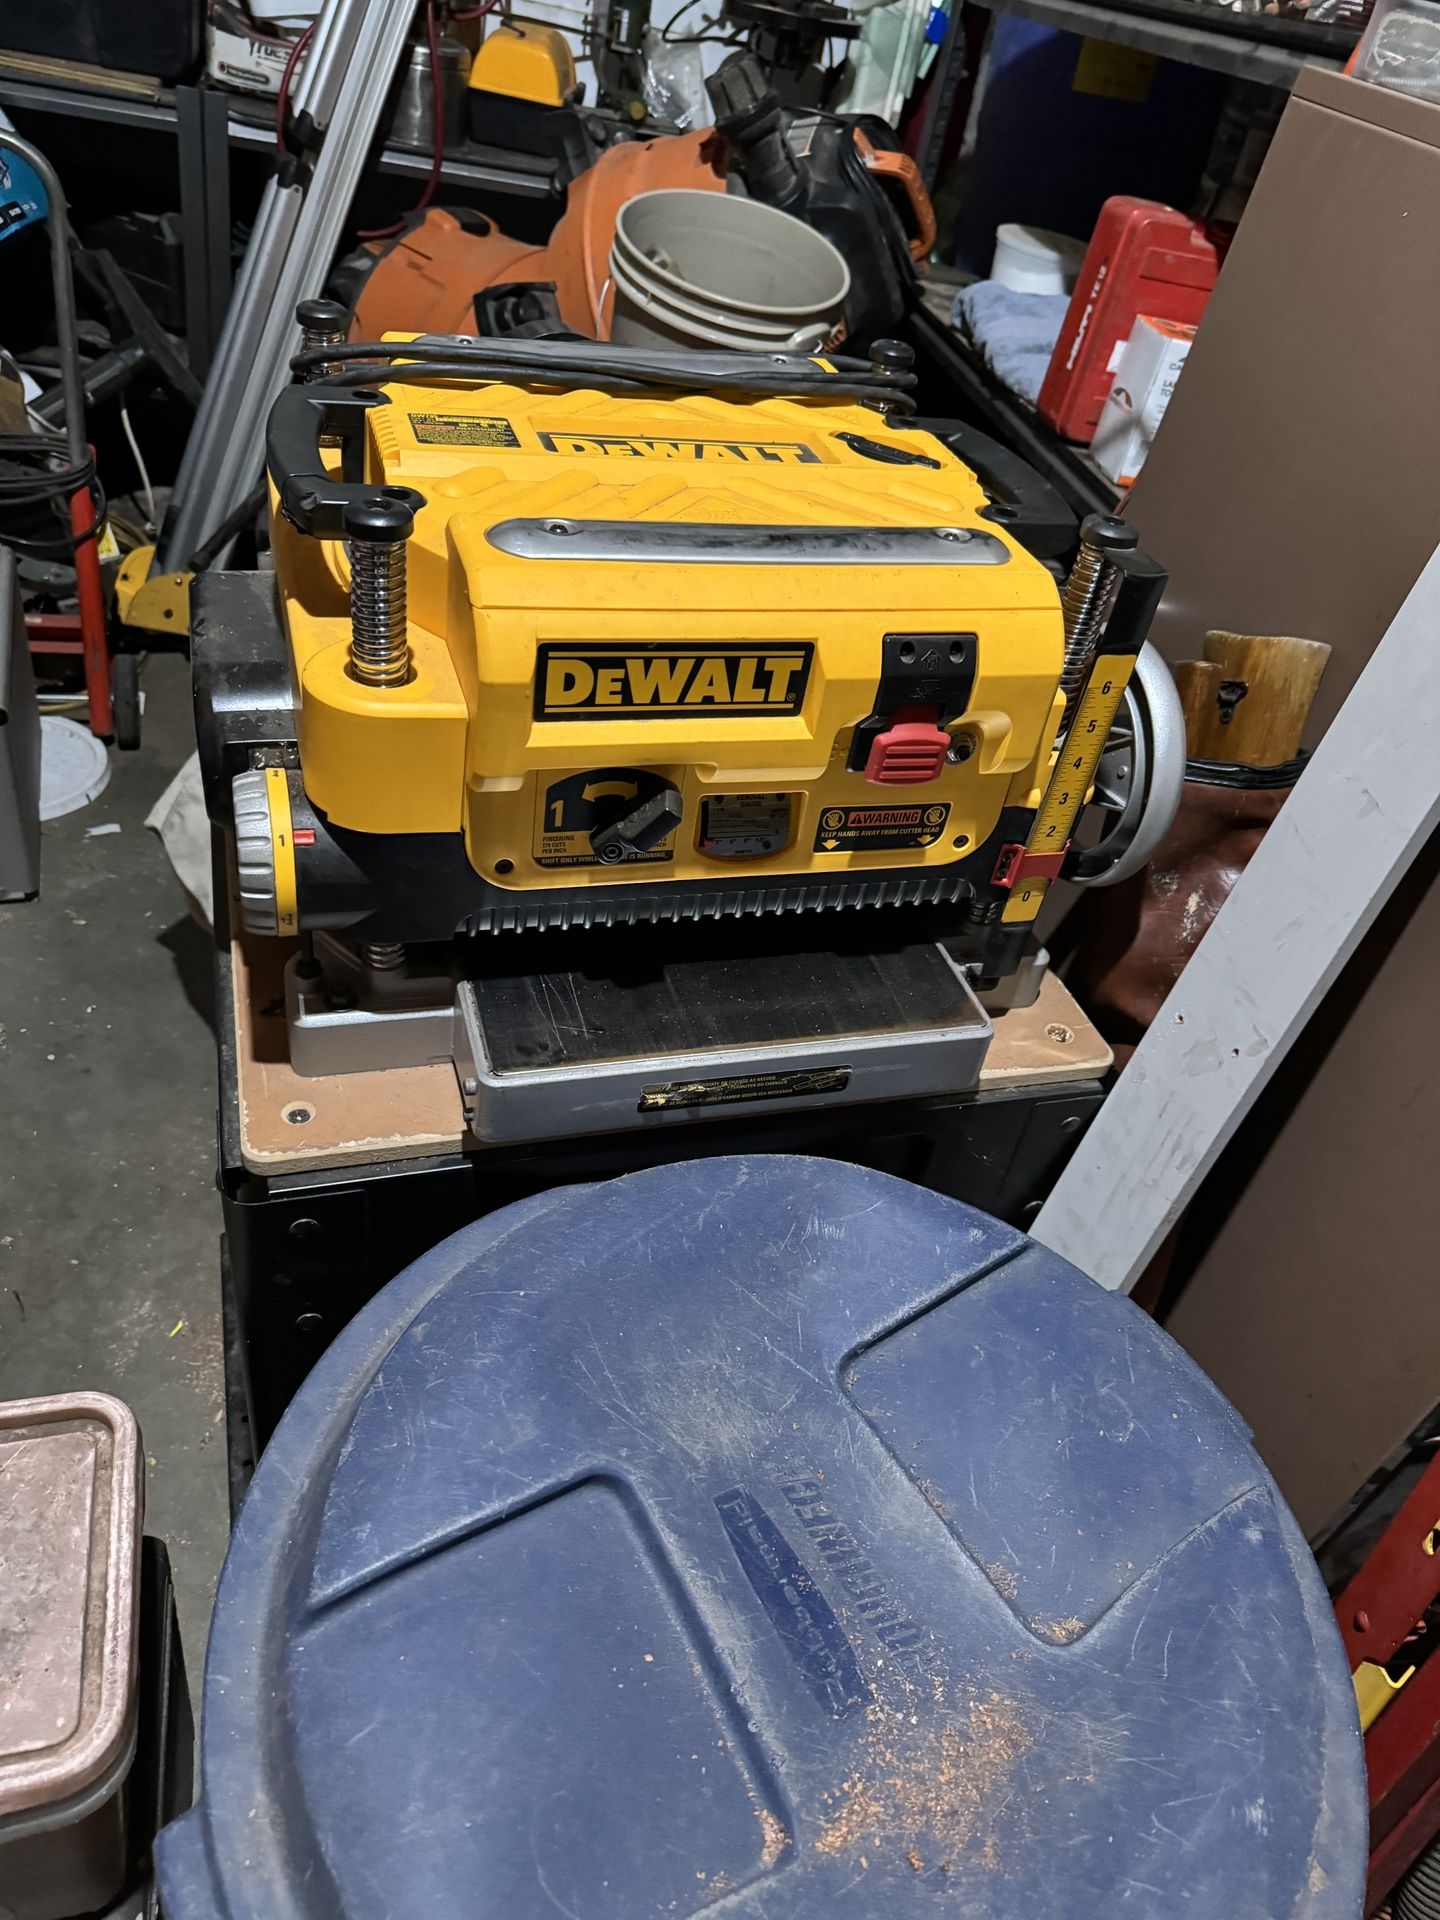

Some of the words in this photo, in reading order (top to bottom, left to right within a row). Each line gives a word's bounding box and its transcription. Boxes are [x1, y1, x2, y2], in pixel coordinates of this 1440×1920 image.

[545, 658, 804, 706] DEWALT
[1101, 681, 1113, 695] 6
[1087, 719, 1096, 733] 5
[1072, 756, 1083, 770] 4
[1058, 792, 1069, 805] 3
[551, 800, 565, 828] 1
[863, 811, 919, 824] WARNING
[1046, 826, 1056, 838] 2
[279, 834, 285, 847] 1
[1022, 891, 1031, 902] 0
